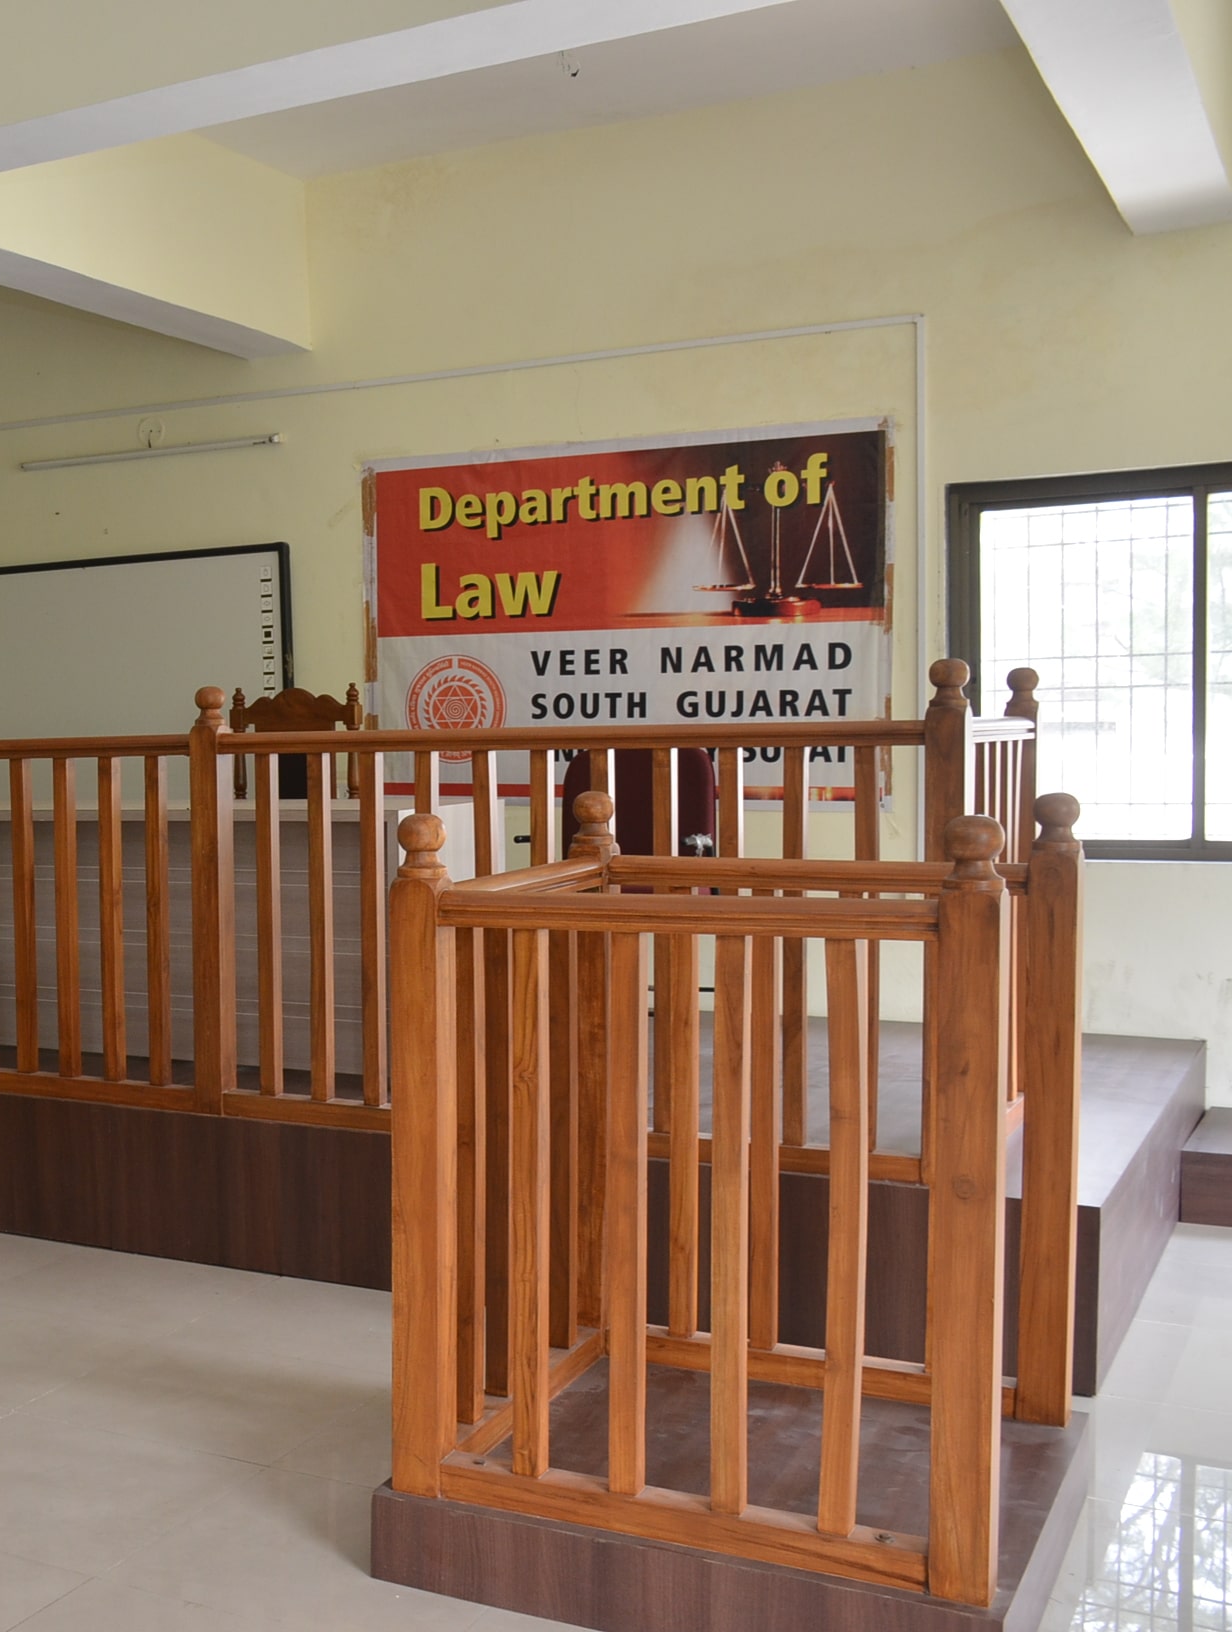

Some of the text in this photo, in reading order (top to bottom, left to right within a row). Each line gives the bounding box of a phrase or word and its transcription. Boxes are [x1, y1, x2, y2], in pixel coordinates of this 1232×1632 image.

[418, 451, 829, 539] Department of
[420, 562, 560, 621] Law
[530, 641, 853, 677] VEER NARMAD
[531, 691, 648, 720] SOUTH
[676, 688, 854, 719] GUJARAT
